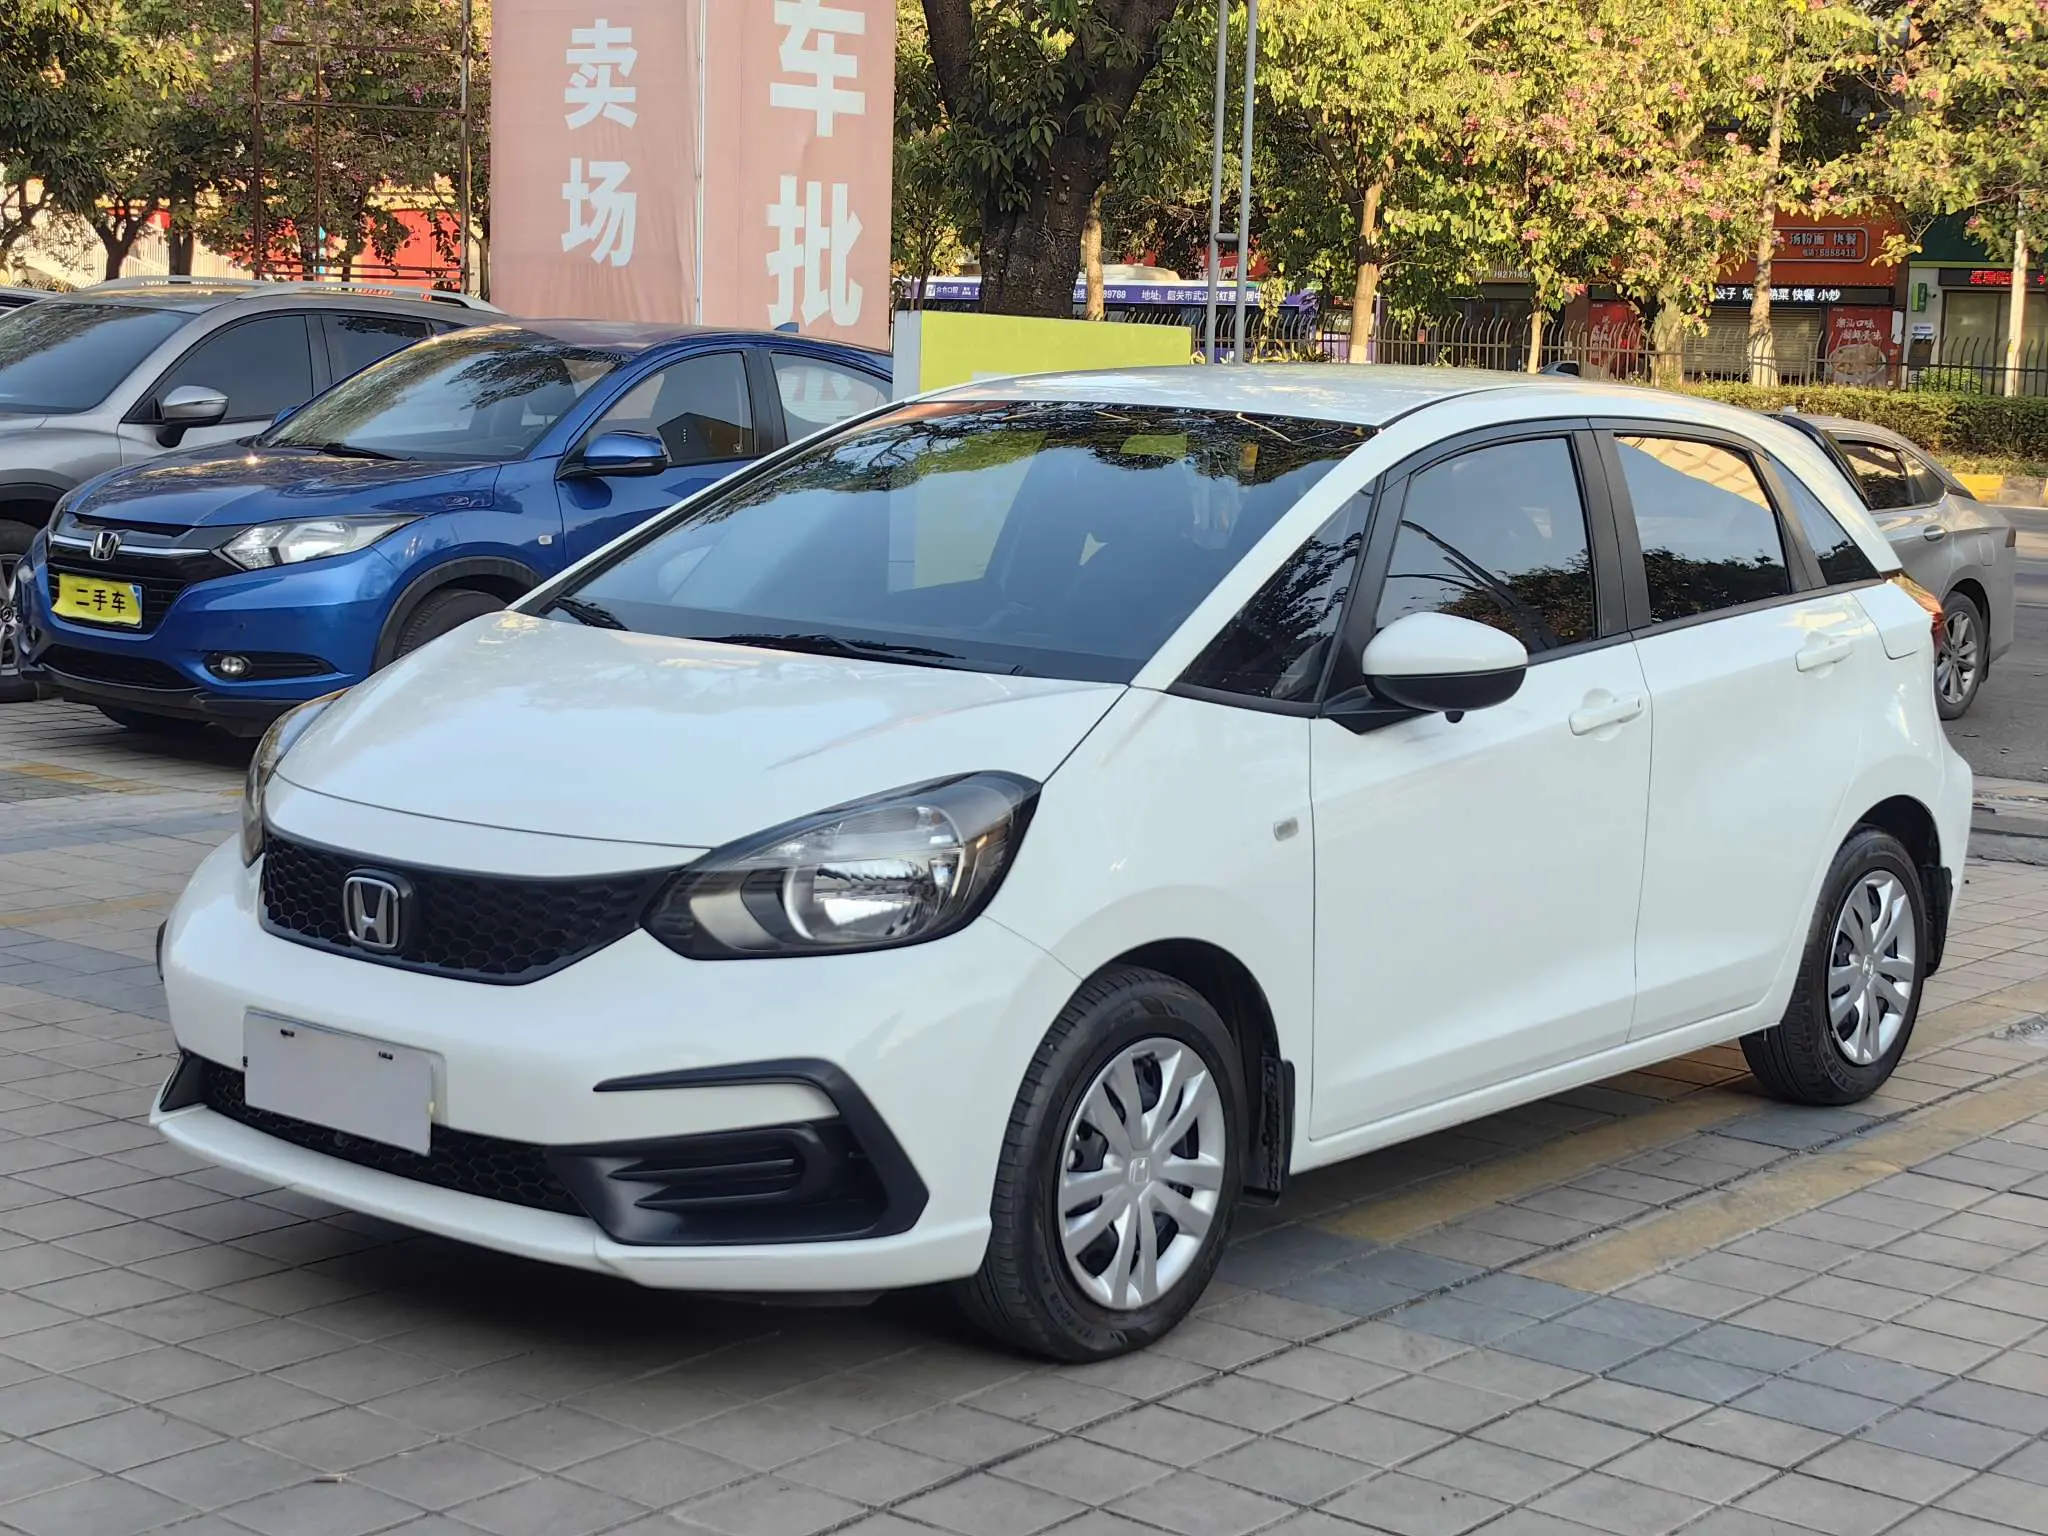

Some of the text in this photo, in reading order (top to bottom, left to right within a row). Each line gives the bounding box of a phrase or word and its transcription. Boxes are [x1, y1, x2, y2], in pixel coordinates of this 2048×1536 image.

[562, 19, 637, 267] 卖场
[1792, 288, 1815, 301] 快餐
[1817, 289, 1840, 301] 小炒
[76, 589, 126, 613] 二手车
